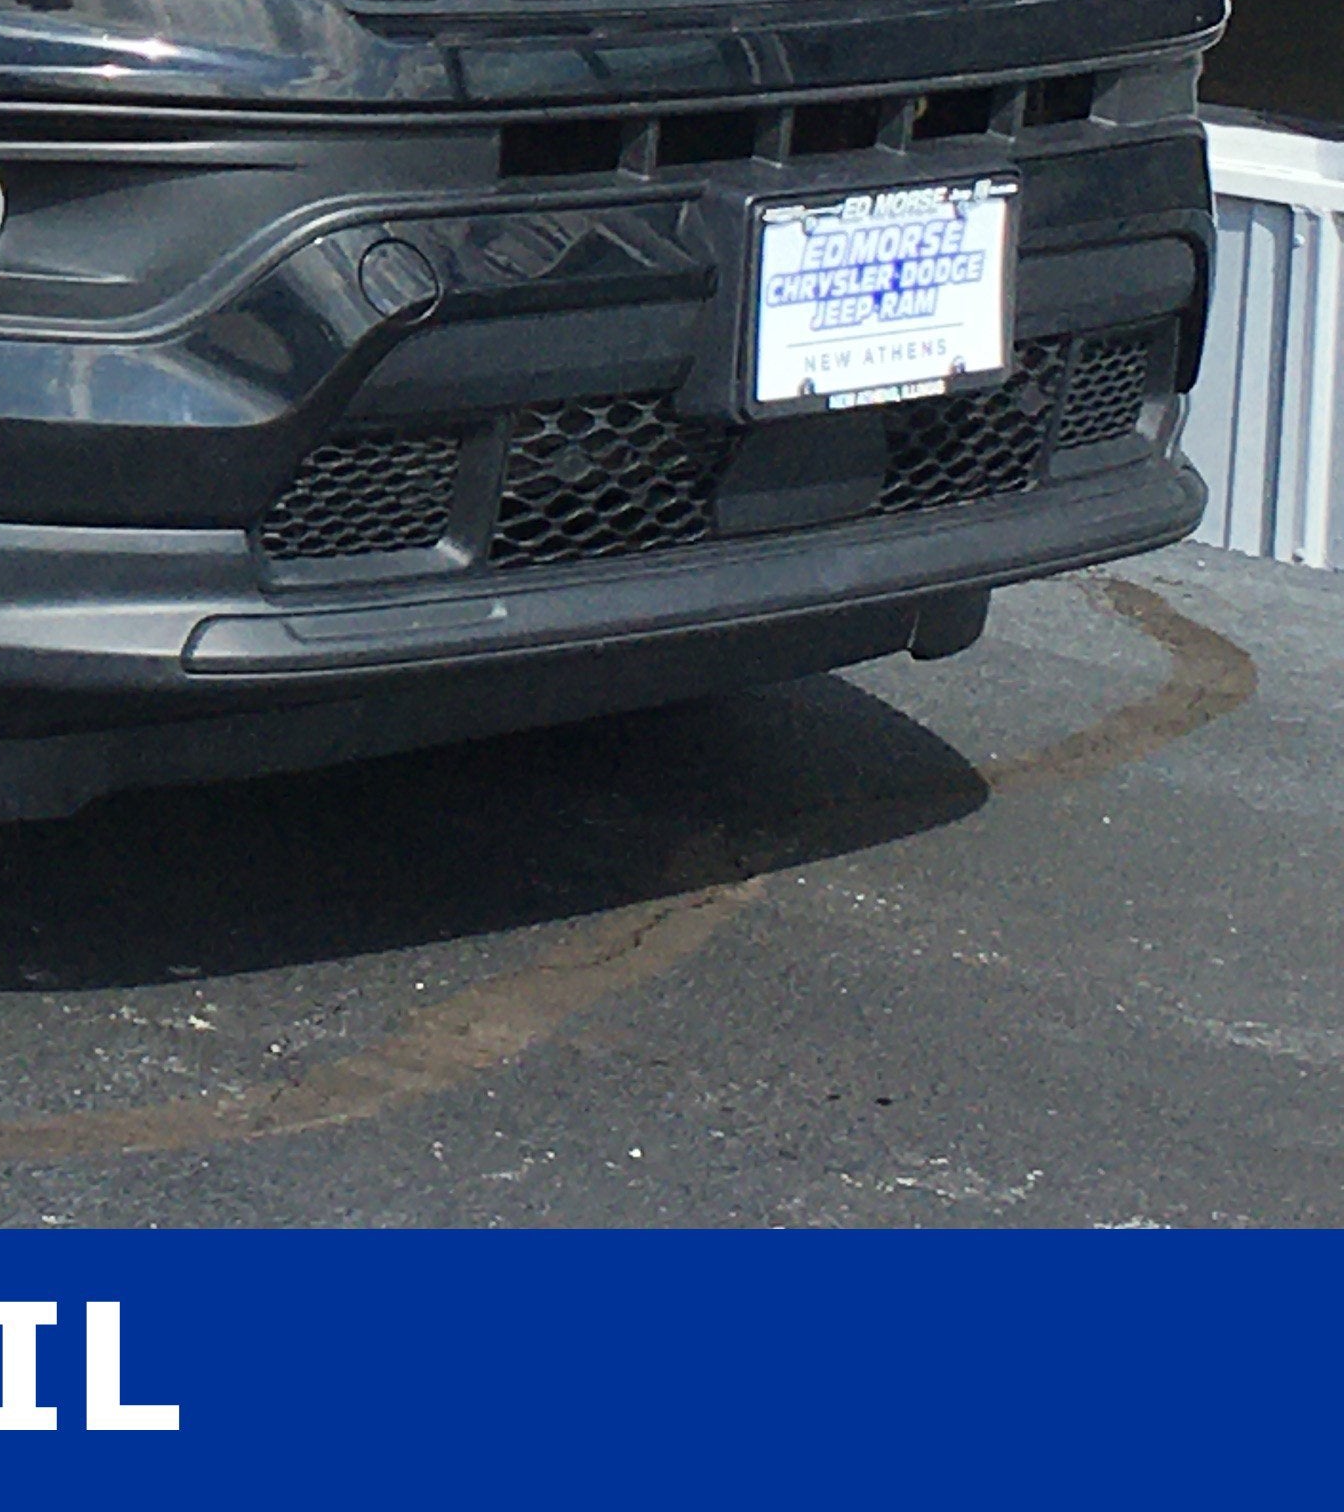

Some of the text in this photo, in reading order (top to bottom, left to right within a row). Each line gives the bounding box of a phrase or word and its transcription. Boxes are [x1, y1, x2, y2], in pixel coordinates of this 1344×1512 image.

[802, 220, 965, 271] ED MORSE
[765, 250, 985, 307] CHRYSLER DODGE
[810, 287, 938, 331] JEEP RAM
[804, 339, 948, 372] NEW ATHENS
